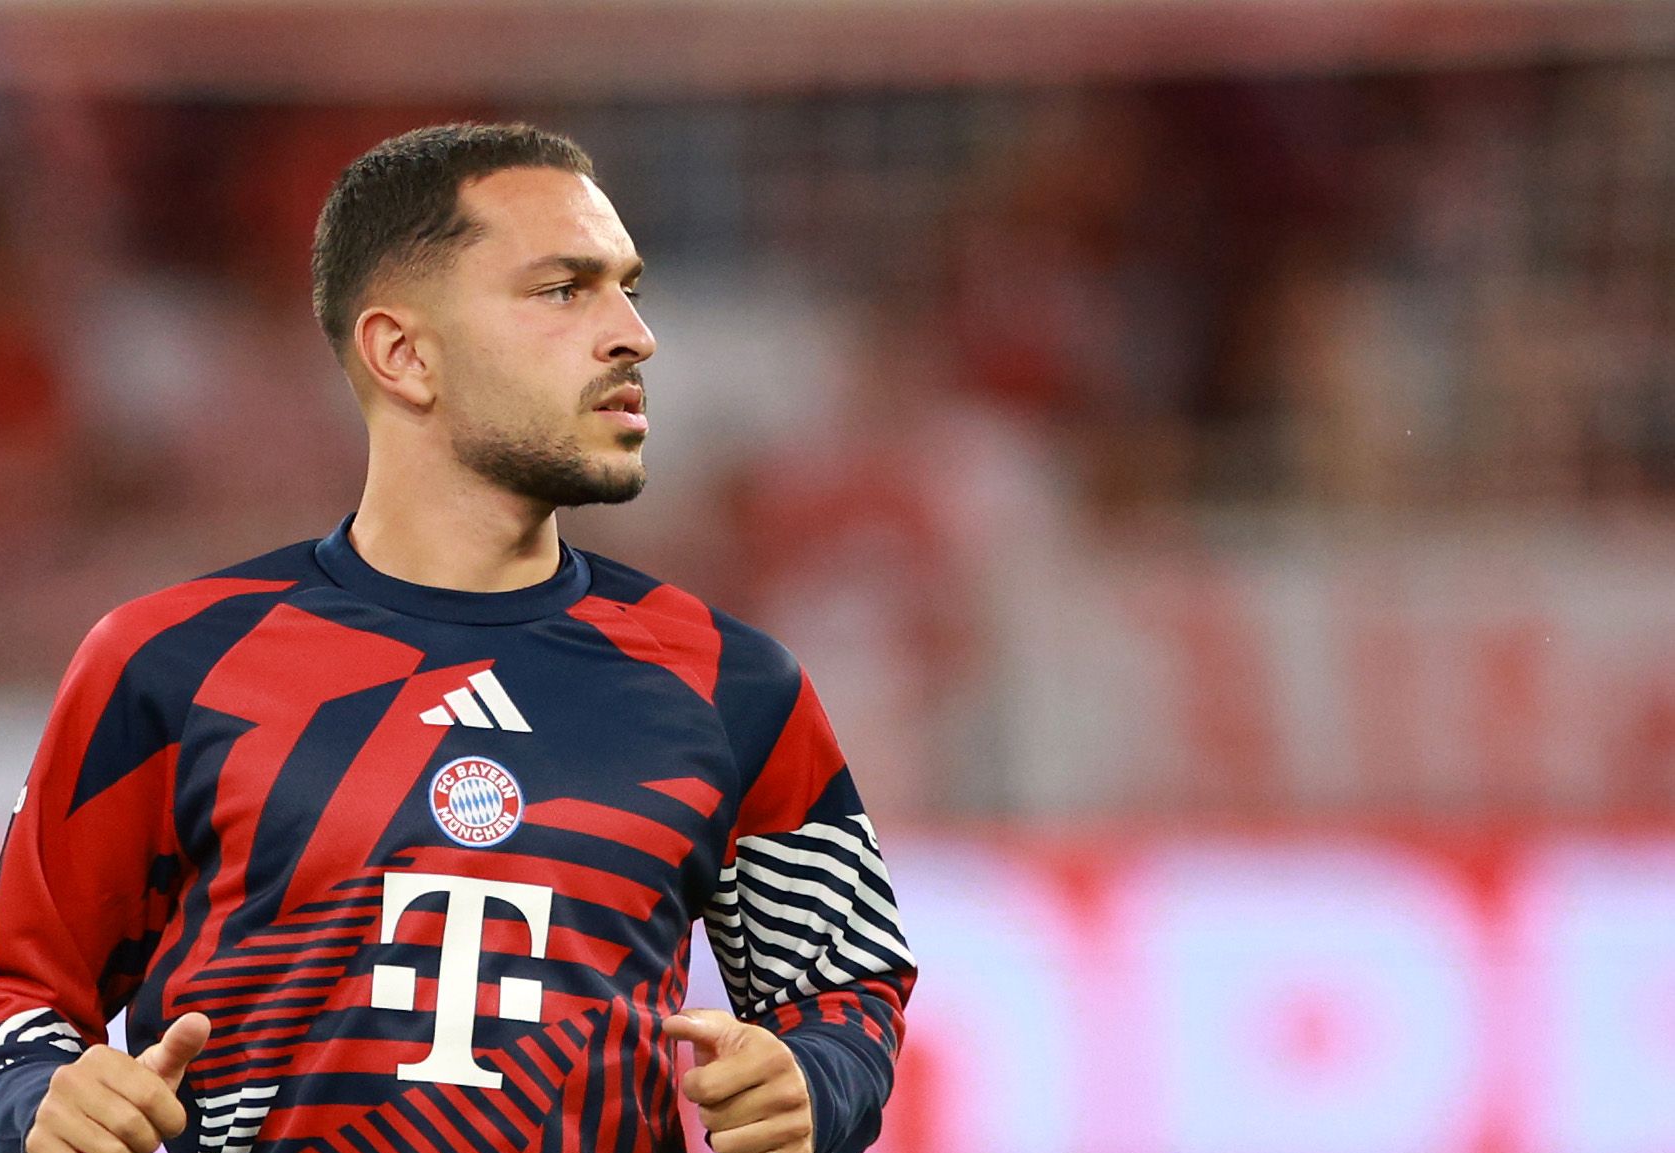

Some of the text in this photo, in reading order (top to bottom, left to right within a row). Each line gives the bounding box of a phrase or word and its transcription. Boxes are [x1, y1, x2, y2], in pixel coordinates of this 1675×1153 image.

[437, 764, 515, 799] FC BAYERN
[371, 871, 553, 1089] T
